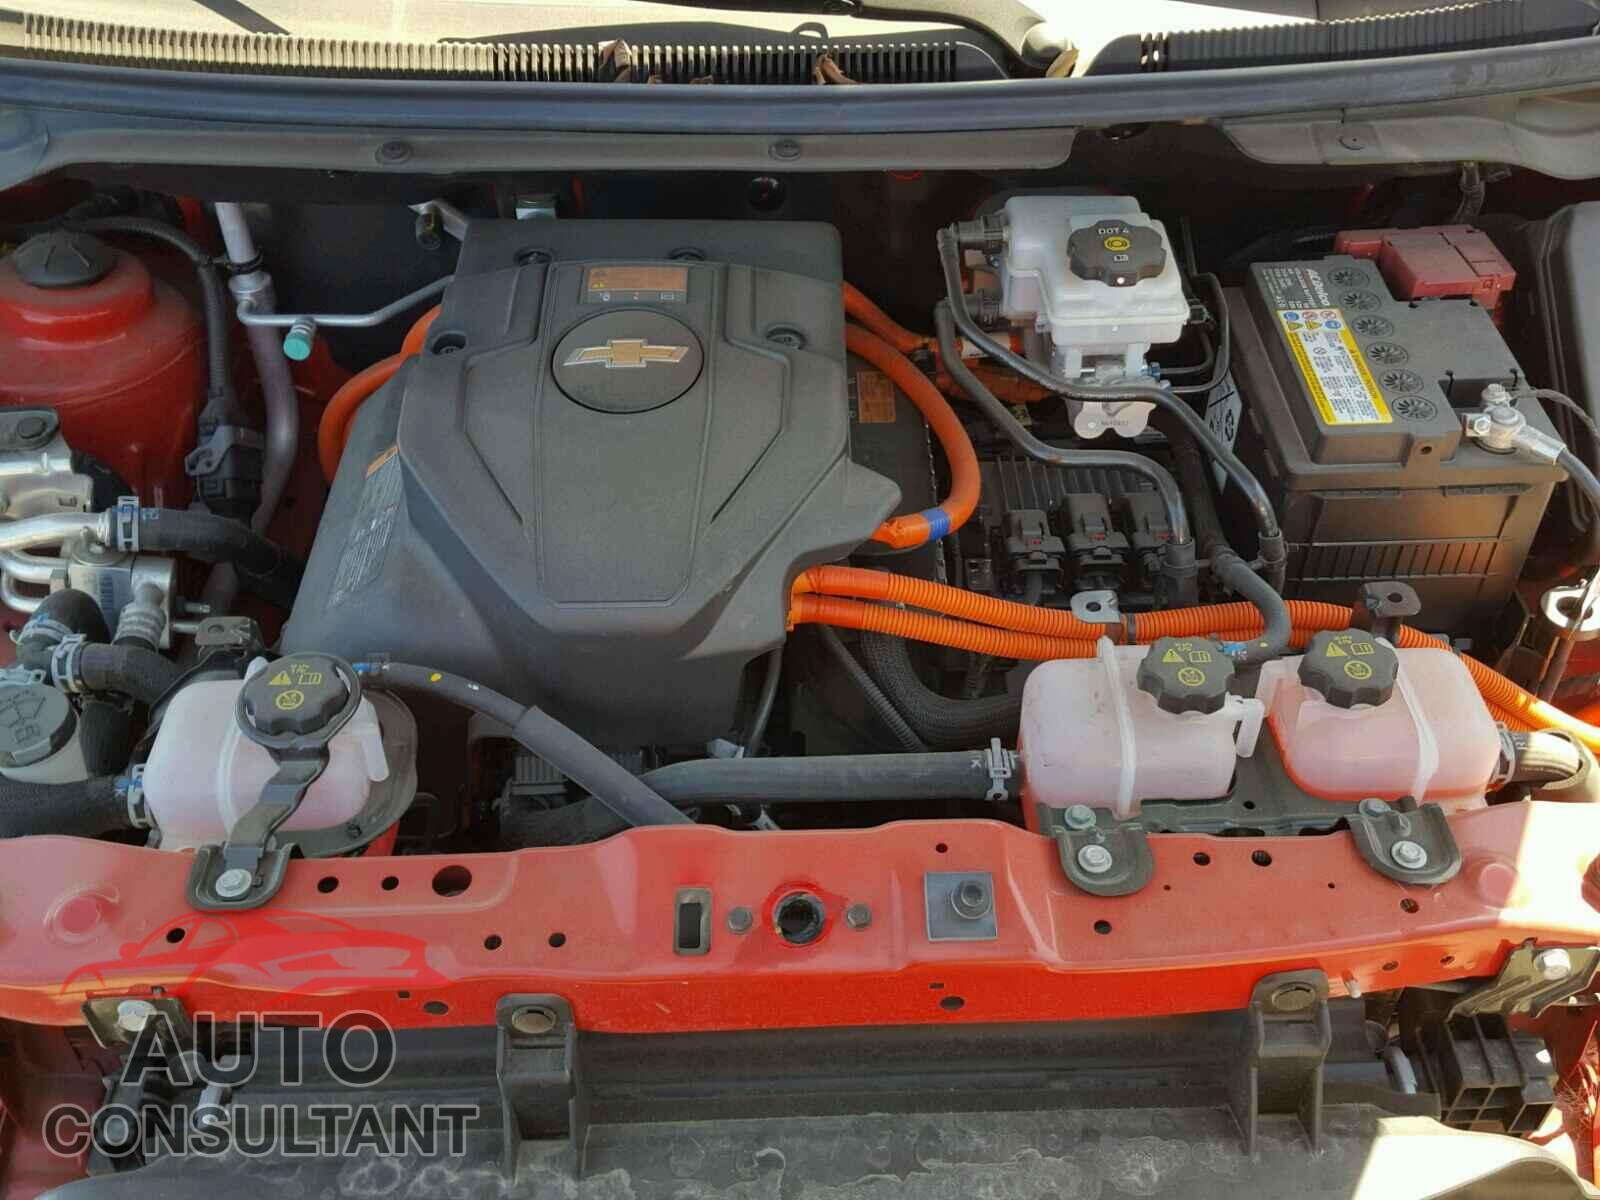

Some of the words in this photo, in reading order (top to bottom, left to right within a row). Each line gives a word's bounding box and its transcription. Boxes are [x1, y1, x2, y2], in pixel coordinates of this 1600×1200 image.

[1098, 226, 1120, 236] DOT
[1122, 226, 1130, 235] 4
[1305, 268, 1331, 306] ACDelco
